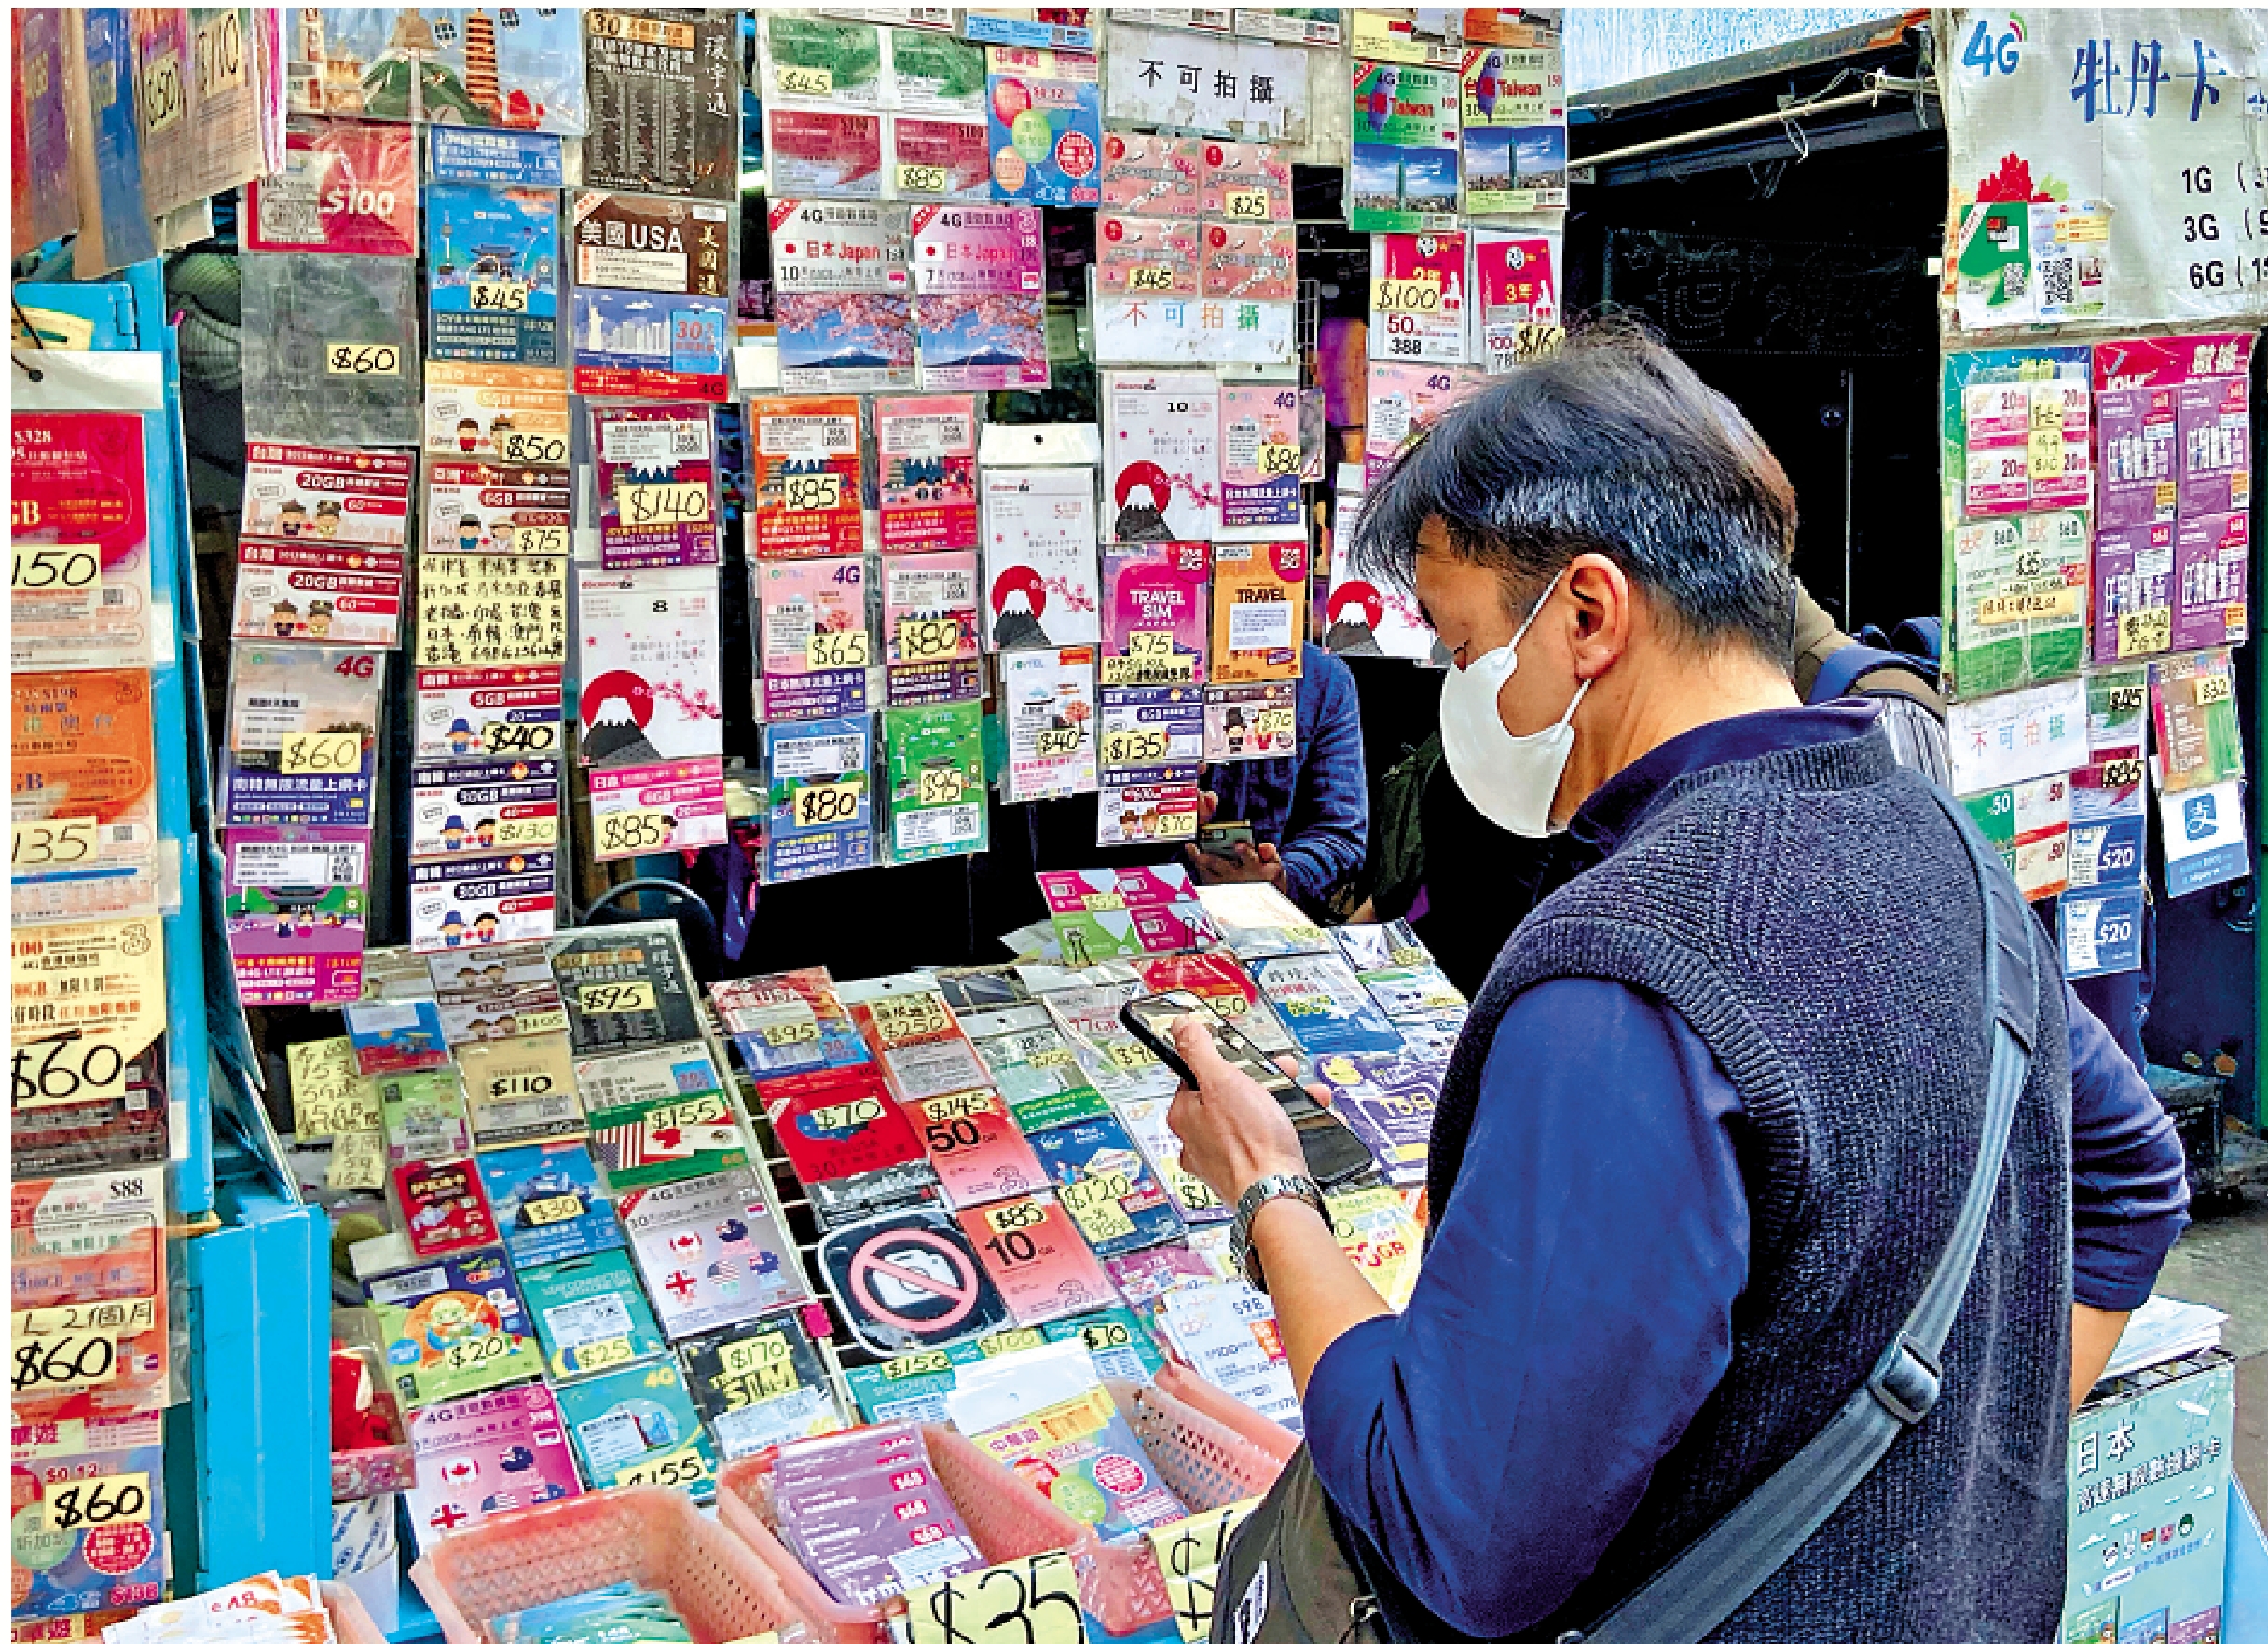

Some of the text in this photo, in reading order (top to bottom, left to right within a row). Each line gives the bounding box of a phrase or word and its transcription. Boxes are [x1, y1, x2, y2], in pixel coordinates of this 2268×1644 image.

[1961, 20, 2020, 77] 4G
[779, 71, 829, 92] $45
[1138, 58, 1275, 104] 不可拍攝
[1497, 79, 1542, 97] Taiwan
[2070, 39, 2228, 122] 牡丹卡
[1392, 98, 1434, 117] Taiwan
[900, 167, 945, 189] $85
[2181, 166, 2212, 194] 1G
[325, 188, 396, 219] $100
[1231, 196, 1266, 217] $25
[800, 208, 825, 224] 4G
[940, 213, 963, 229] 4G
[2183, 213, 2220, 243] 3G
[580, 220, 684, 252] 美國 USA
[806, 240, 882, 264] 日本 Japan
[946, 242, 1016, 265] 日本 Japan
[1134, 269, 1173, 290] $45
[2189, 260, 2225, 290] 6G
[472, 285, 526, 310] $45
[1377, 281, 1438, 310] $100
[1122, 301, 1260, 331] 不可拍攝
[1386, 315, 1414, 335] 50
[331, 346, 396, 374] $60
[699, 381, 725, 397] 4G
[1426, 374, 1451, 391] 4G
[1167, 401, 1189, 414] 10
[1273, 391, 1296, 409] 4G
[506, 434, 565, 461] $50
[300, 473, 346, 490] 20GB
[789, 476, 837, 511] $85
[630, 485, 706, 523] $140
[518, 528, 562, 552] $75
[293, 573, 338, 590] 20GB
[832, 564, 860, 585] 4G
[1129, 589, 1185, 606] TRAVEL
[1235, 588, 1286, 603] TRAVEL
[1142, 604, 1173, 620] SIM
[812, 634, 866, 666] $65
[905, 621, 958, 658] $80
[1132, 632, 1170, 654] $75
[334, 655, 375, 678] 4G
[2110, 688, 2144, 711] $45
[1260, 711, 1293, 733] $70
[488, 724, 555, 754] $40
[1038, 731, 1080, 754] $40
[1110, 732, 1162, 760] $135
[285, 737, 358, 770] $60
[2103, 761, 2144, 786] $85
[922, 771, 961, 801] $95
[800, 789, 857, 824] $80
[498, 822, 556, 841] $130
[602, 813, 662, 850] $85
[1159, 814, 1192, 836] $70
[2101, 847, 2135, 869] $20
[2097, 921, 2132, 944] $20
[584, 985, 642, 1009] $95
[766, 1024, 816, 1046] $95
[884, 1016, 945, 1039] $250
[11, 1039, 123, 1107] $60
[489, 1076, 553, 1098] $110
[652, 1100, 717, 1128] $155
[816, 1099, 881, 1131] $70
[927, 1092, 989, 1121] $145
[925, 1119, 980, 1153] 50
[109, 1178, 144, 1199] $88
[648, 1186, 675, 1202] 4G
[1065, 1177, 1130, 1212] $120
[531, 1198, 579, 1221] $30
[995, 1201, 1044, 1229] $85
[985, 1230, 1036, 1267] 10
[448, 1336, 504, 1369] $20
[980, 1329, 1037, 1353] $100
[11, 1336, 114, 1392] $60
[577, 1343, 632, 1369] $25
[730, 1342, 786, 1369] $170
[886, 1353, 951, 1378] $150
[724, 1365, 791, 1412] SIM
[424, 1407, 454, 1425] 4G
[2077, 1418, 2136, 1477] 日本
[894, 1473, 924, 1491] $68
[53, 1481, 145, 1530] $60
[898, 1502, 928, 1519] $68
